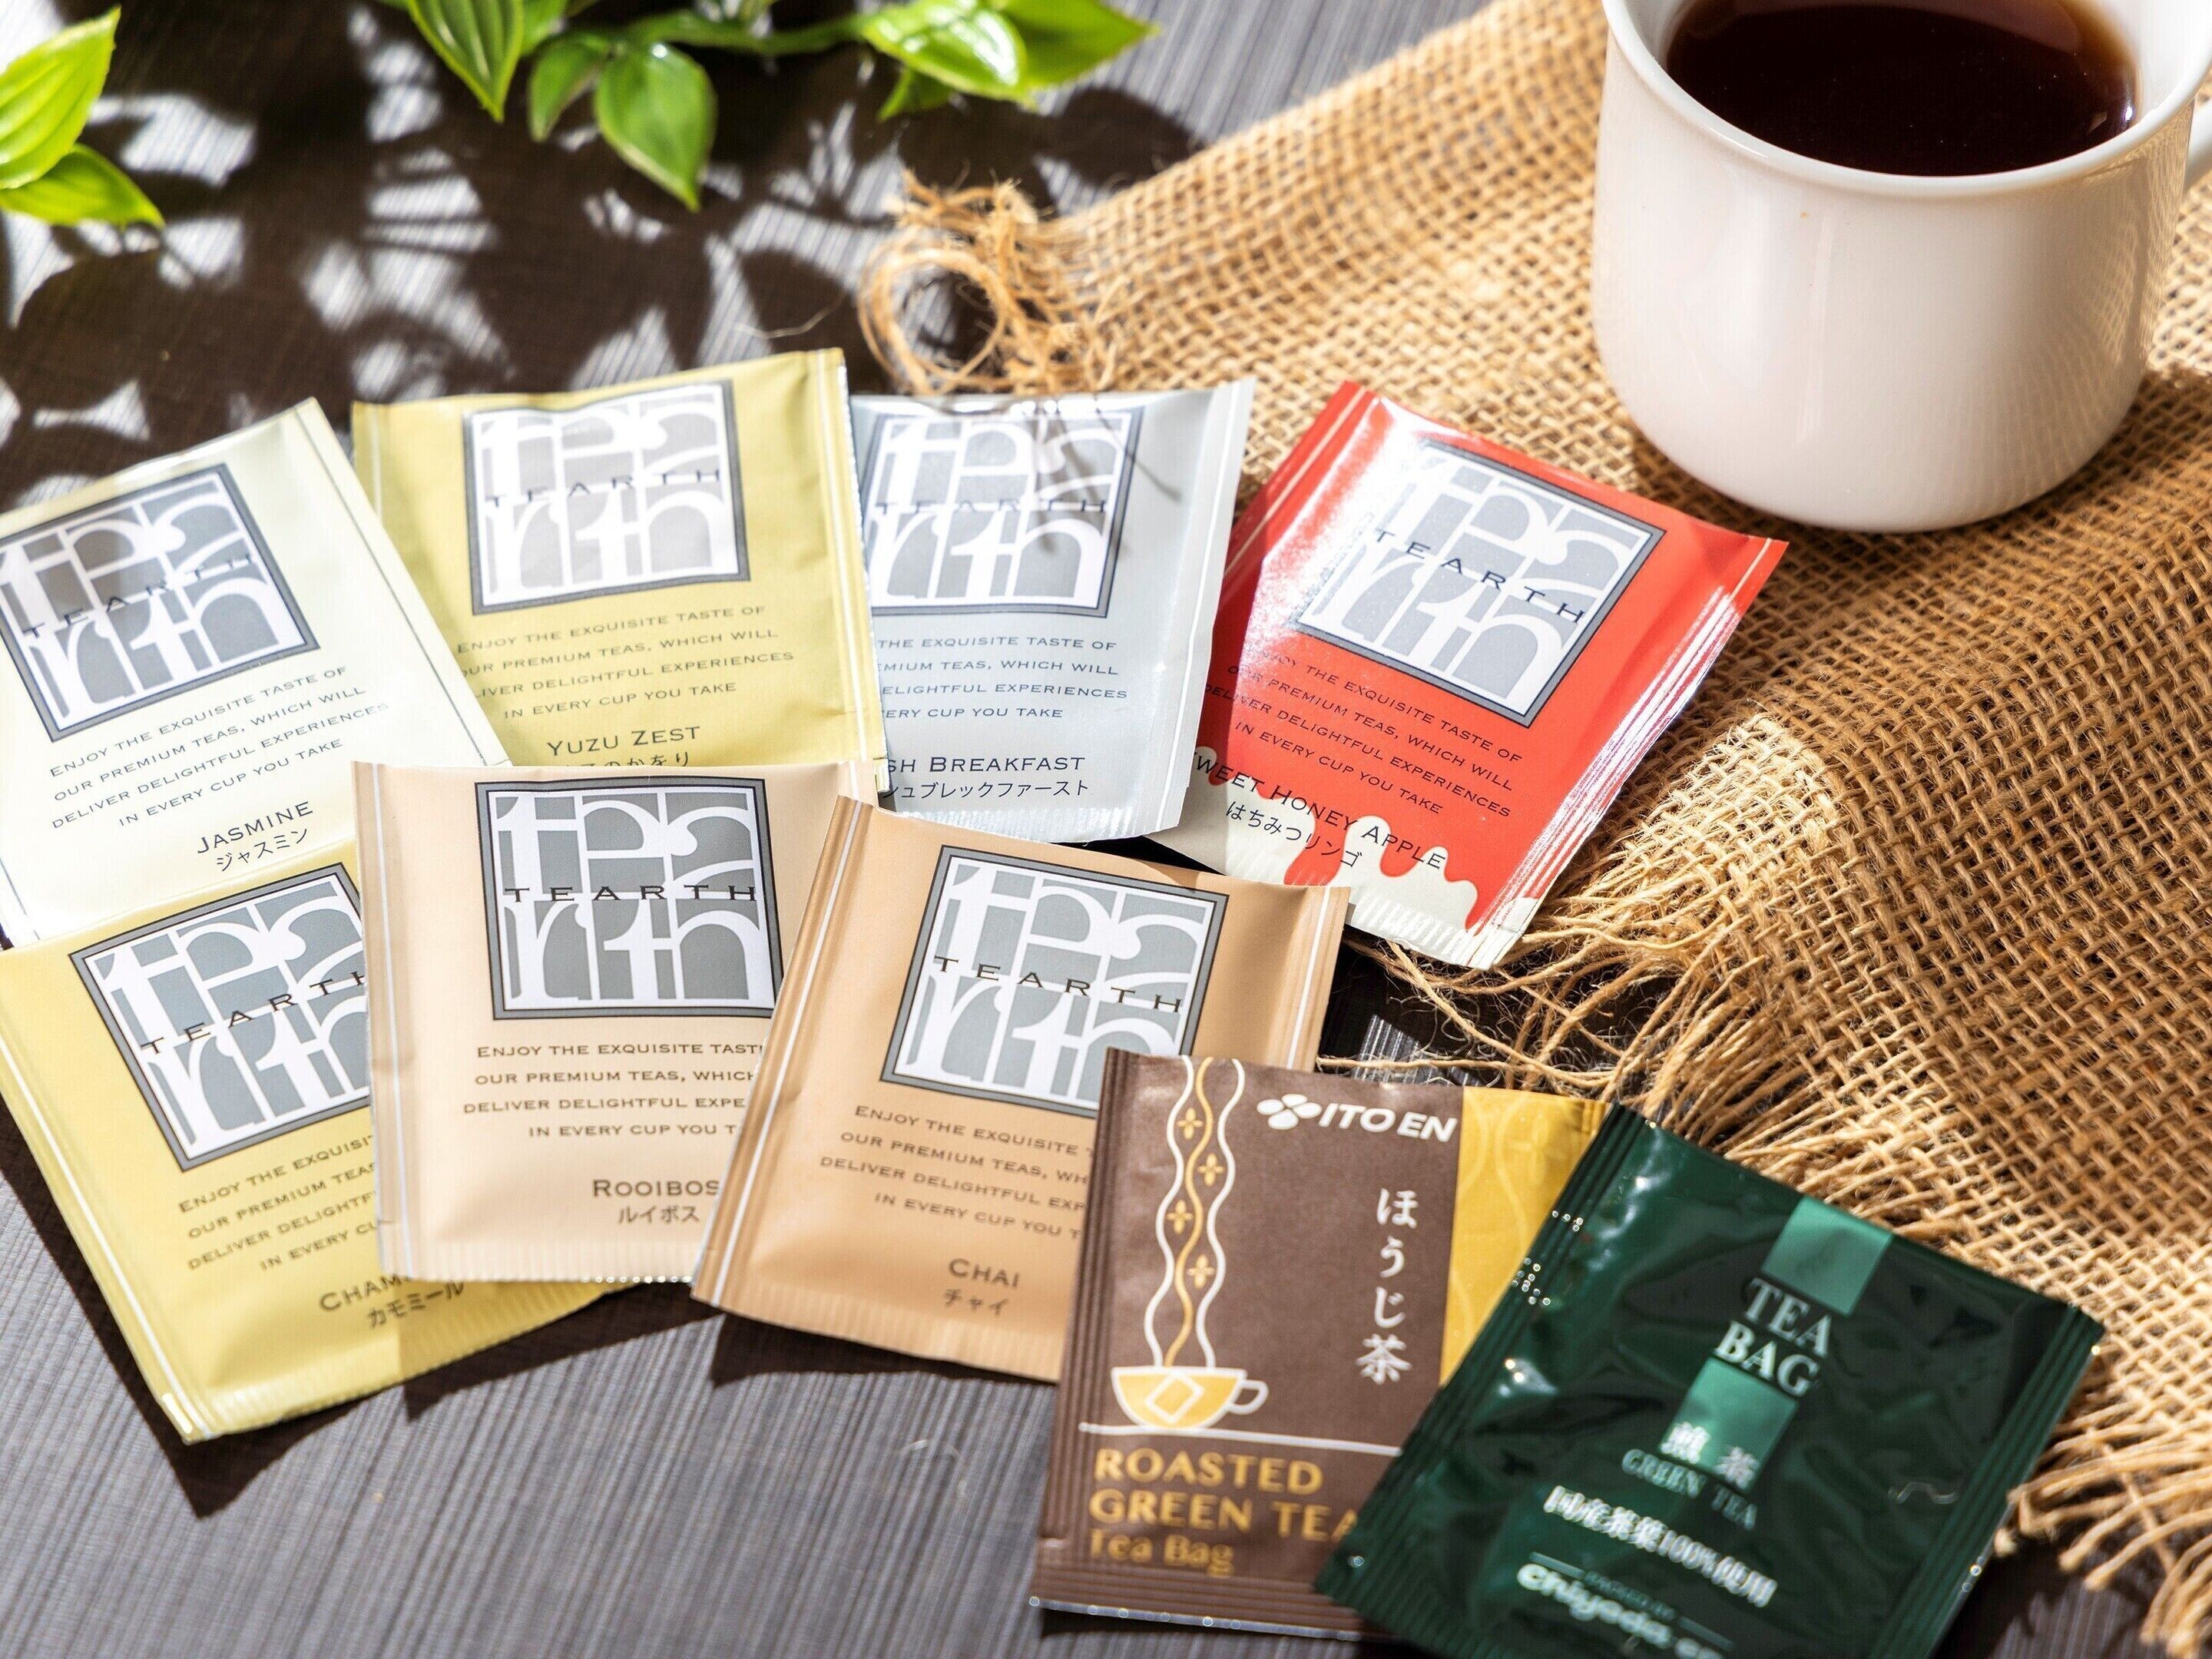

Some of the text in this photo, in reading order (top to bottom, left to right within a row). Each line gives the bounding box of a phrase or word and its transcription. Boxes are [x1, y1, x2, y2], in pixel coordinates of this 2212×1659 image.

[1374, 528, 1585, 624] TEARTH
[457, 606, 765, 655] ENJOY THE EXQUISITE TASTE OF
[502, 651, 591, 671] PREMIUM
[598, 643, 652, 658] TEAS,
[659, 633, 723, 649] WHICH
[730, 629, 779, 641] WILL
[878, 636, 1118, 651] THE EXQUISITE TASTE OF
[532, 667, 654, 691] DELIGHTFUL
[661, 651, 795, 674] EXPERIENCES
[881, 684, 1128, 700] ELIGHTFUL EXPERIENCES
[941, 661, 992, 671] TEAS,
[1000, 660, 1064, 671] WHICH
[1071, 663, 1119, 676] WILL
[49, 667, 346, 778] ENJOY THE EXQUISITE TASTE OF
[504, 682, 737, 720] IN EVERY CUP YOU TAKE
[886, 707, 1064, 719] ERY CUP YOU TAKE
[1306, 664, 1340, 686] THE
[1343, 680, 1436, 725] EXQUISITE
[1440, 720, 1494, 752] TASTE
[1497, 748, 1523, 763] OF
[54, 687, 366, 802] OUR PREMIUM TEAS, WHICH WILL
[546, 725, 701, 757] YUZU ZEST
[1267, 678, 1349, 717] PREMIUM
[1353, 711, 1399, 740] TEAS,
[1408, 733, 1467, 768] WHICH
[1471, 763, 1512, 792] WILL
[51, 703, 389, 830] DELIVER DELIGHTFUL EXPERIENCES
[119, 738, 343, 827] IN EVERY CUP YOU TAKE
[929, 757, 1086, 773] BREAKFAST
[1235, 721, 1444, 815] IN EVERY CUP YOU TAKE
[1277, 710, 1384, 761] DELIGHTFUL
[1389, 756, 1512, 818] EXPERIENCES
[197, 800, 314, 855] JASMINE
[1194, 752, 1446, 871] WEET HONEY APPLE
[1225, 800, 1363, 869] はちみつリンゴ
[217, 828, 308, 873] ジャスミン
[504, 883, 758, 904] TEARTH
[933, 955, 1182, 1015] TEARTH
[477, 1044, 763, 1058] ENJOY THE EXQUISITE TAST
[475, 1073, 518, 1086] OUR
[525, 1071, 621, 1084] PREMIUM
[628, 1070, 686, 1083] TEAS,
[463, 1099, 551, 1115] DELIVER
[558, 1098, 688, 1110] DELIGHTFUL
[528, 1127, 551, 1137] IN
[558, 1124, 623, 1137] EVERY
[630, 1124, 671, 1136] CUP
[677, 1124, 717, 1136] YOU
[854, 1104, 920, 1127] ENJOY
[926, 1119, 966, 1137] THE
[972, 1128, 1079, 1157] EXQUISITE
[1318, 1102, 1458, 1143] ITO EN
[840, 1131, 883, 1148] OUR
[890, 1140, 985, 1168] PREMIUM
[992, 1158, 1048, 1180] TEAS,
[178, 1181, 240, 1214] ENJOY
[246, 1165, 288, 1187] THE
[593, 1179, 720, 1198] ROOIBOS
[820, 1156, 906, 1180] DELIVER
[912, 1172, 1041, 1206] DELIGHTFUL
[187, 1190, 376, 1271] DELIVER DELIGHTF
[188, 1216, 230, 1239] OUR
[235, 1180, 328, 1220] PREMIUM
[618, 1204, 700, 1225] ルイボス
[874, 1193, 897, 1207] IN
[903, 1197, 969, 1220] EVERY
[974, 1211, 1016, 1227] CUP
[1022, 1220, 1063, 1237] YOU
[260, 1255, 283, 1270] IN
[288, 1230, 349, 1260] EVERY
[949, 1258, 1020, 1288] CHAI
[944, 1289, 1008, 1316] チャイ
[1355, 1187, 1419, 1384] ほうじ茶
[1744, 1276, 1833, 1358] TEA
[1714, 1320, 1820, 1398] BAG
[1094, 1447, 1324, 1496] ROASTED
[1088, 1487, 1359, 1543] GREEN TEA
[1088, 1528, 1235, 1578] Tea Bag
